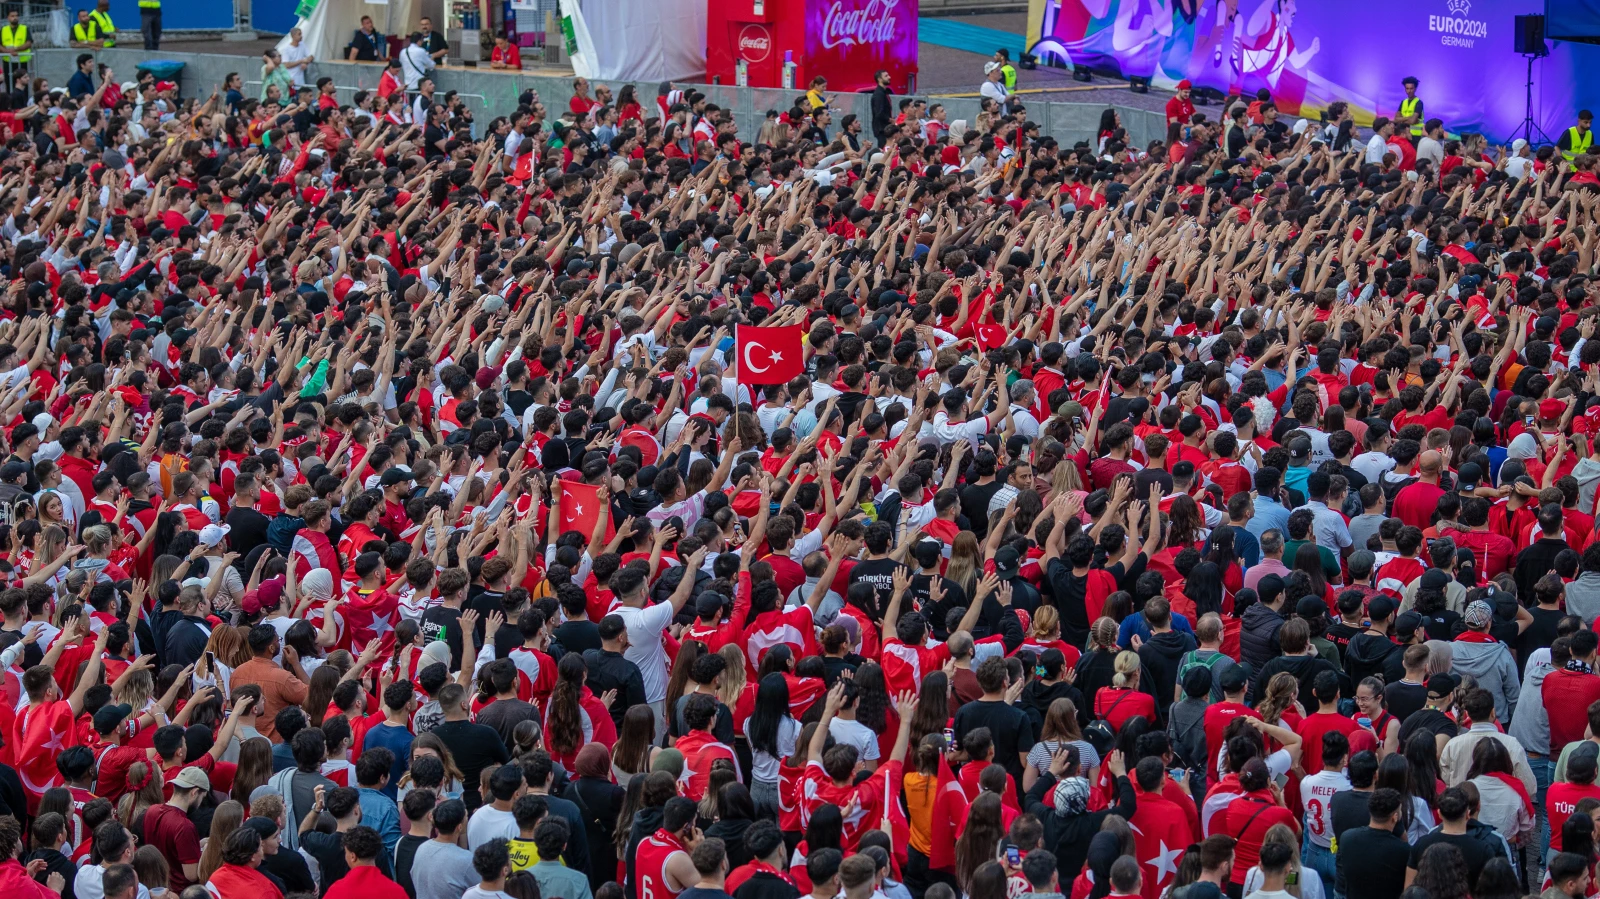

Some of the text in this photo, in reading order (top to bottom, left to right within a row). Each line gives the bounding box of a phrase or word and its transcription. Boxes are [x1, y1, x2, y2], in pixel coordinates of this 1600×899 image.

[1447, 0, 1470, 15] UEFA
[823, 0, 896, 50] Coca-Cola
[1441, 35, 1475, 49] GERMANY
[858, 573, 893, 584] TÜRKİYE
[1311, 785, 1338, 797] MELEK
[1554, 800, 1576, 815] TÜR
